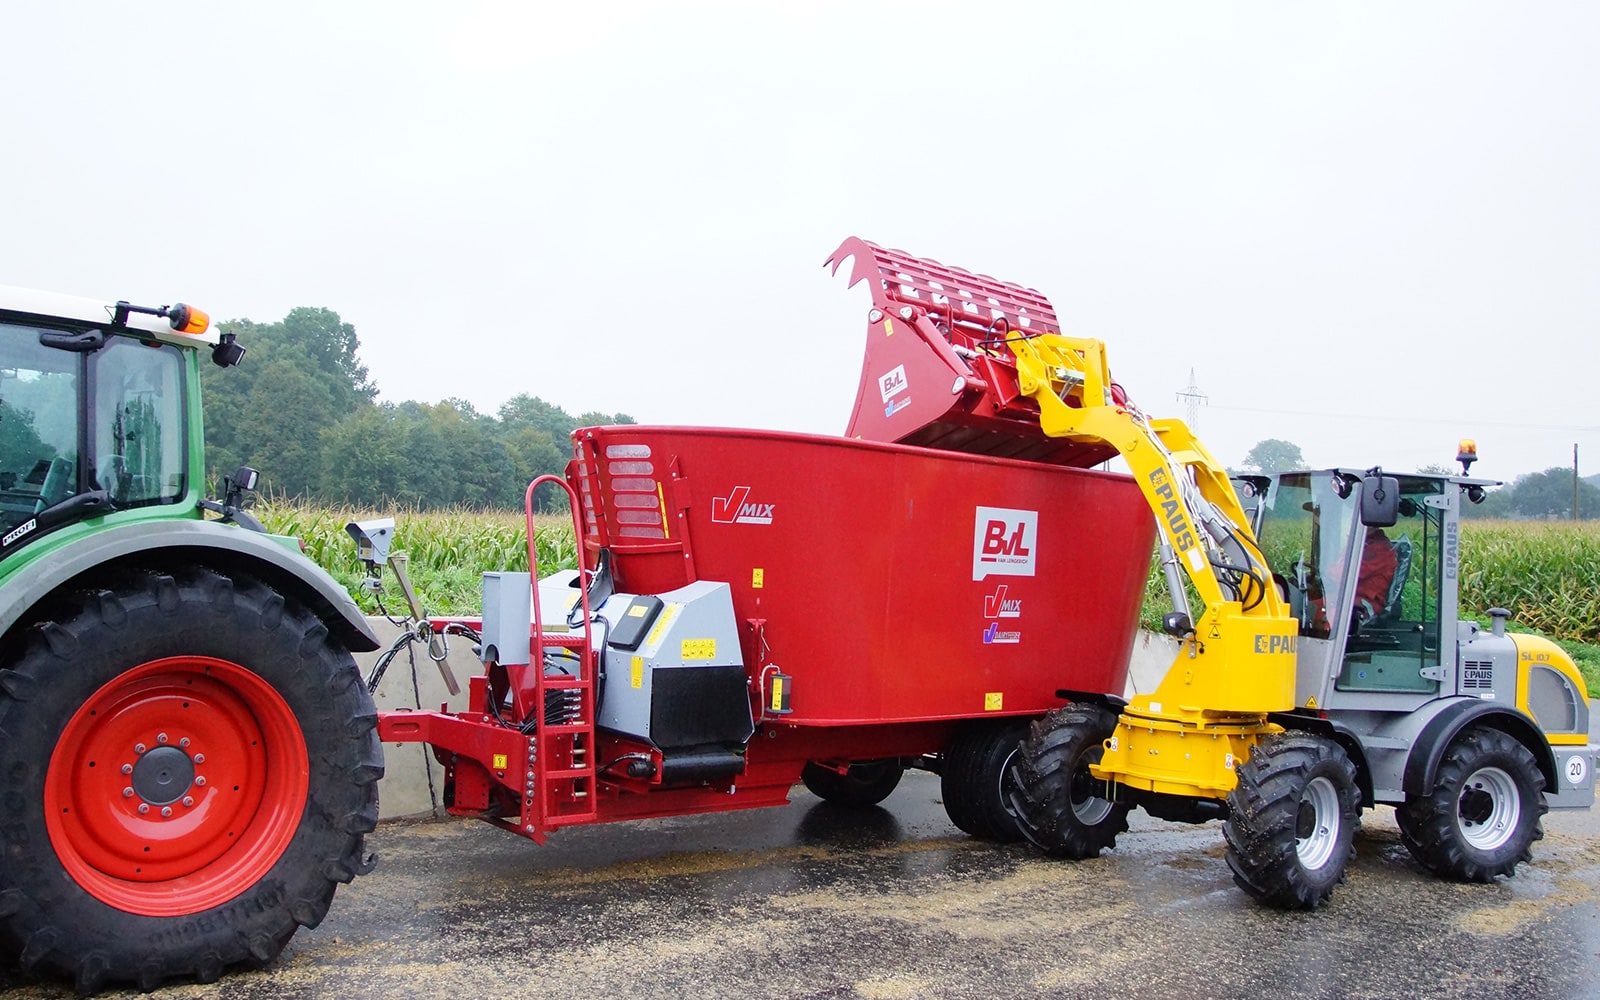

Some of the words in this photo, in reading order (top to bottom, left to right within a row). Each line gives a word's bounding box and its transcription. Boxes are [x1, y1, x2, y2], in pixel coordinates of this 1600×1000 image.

[4, 520, 36, 544] PROFI
[1269, 635, 1299, 654] PAU
[1521, 652, 1534, 661] SL
[1570, 762, 1582, 776] 20
